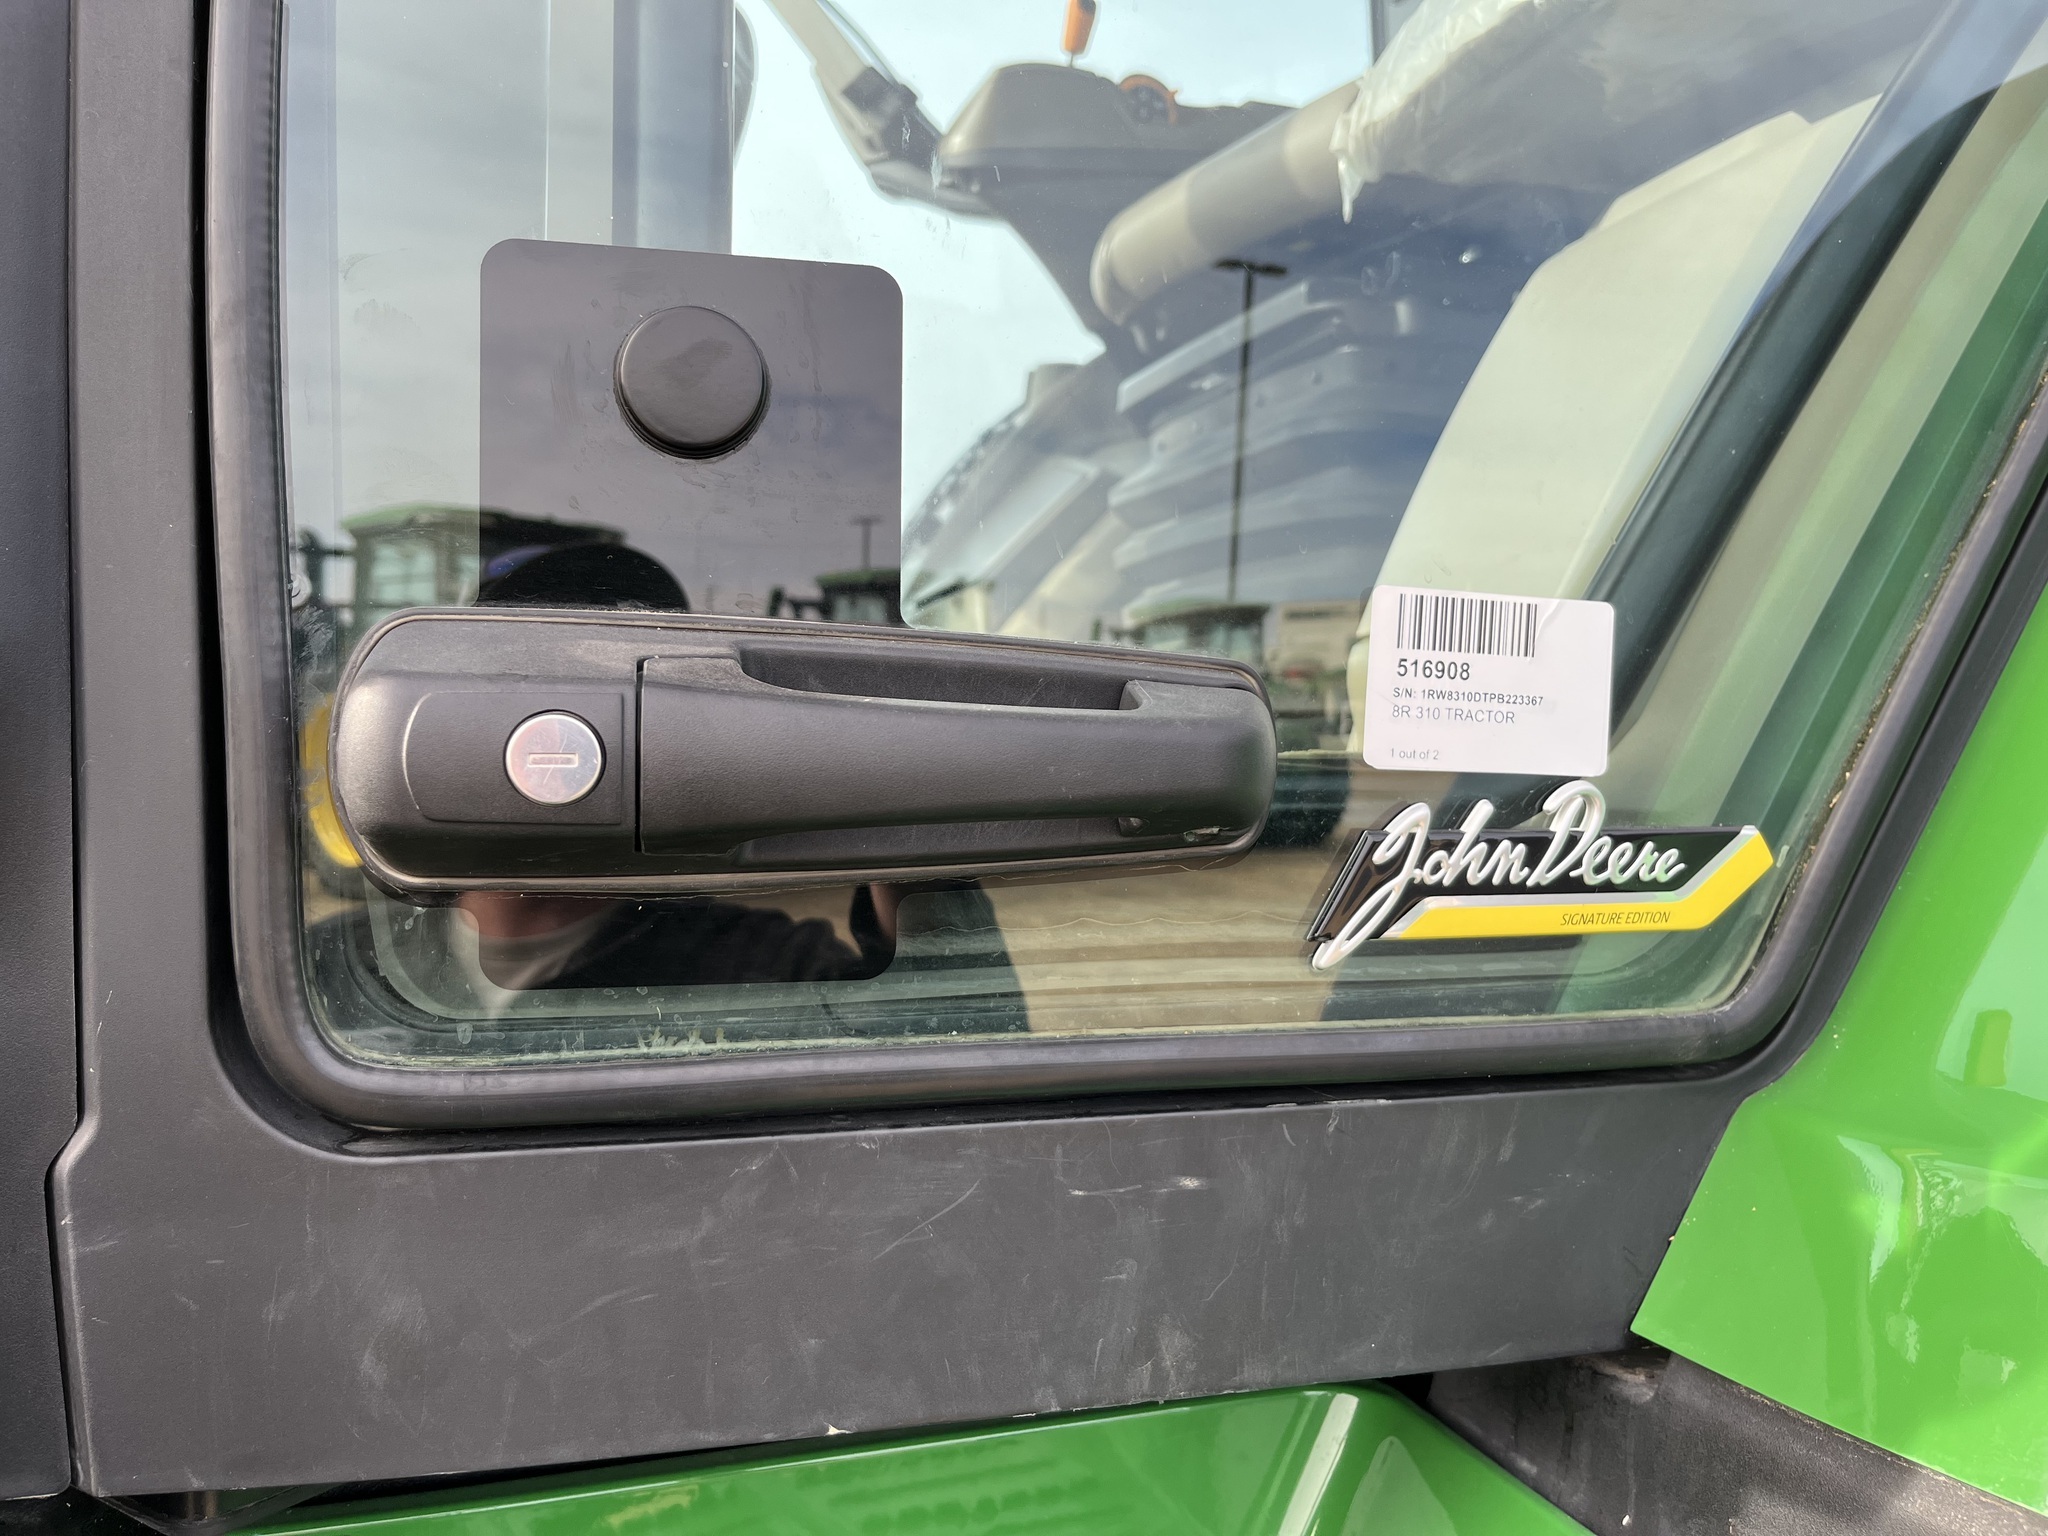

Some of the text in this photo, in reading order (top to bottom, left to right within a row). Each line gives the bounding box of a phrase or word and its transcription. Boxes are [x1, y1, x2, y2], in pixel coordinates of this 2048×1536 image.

[1396, 658, 1471, 681] 516908
[1392, 687, 1543, 706] S/N: 1RW8310DTPB223367
[1392, 705, 1516, 724] 8R 310 TRACTOR
[1390, 748, 1440, 760] 1 out of 2
[1311, 780, 1687, 971] John Deere
[1560, 911, 1671, 926] SIGNATURE EDITION
